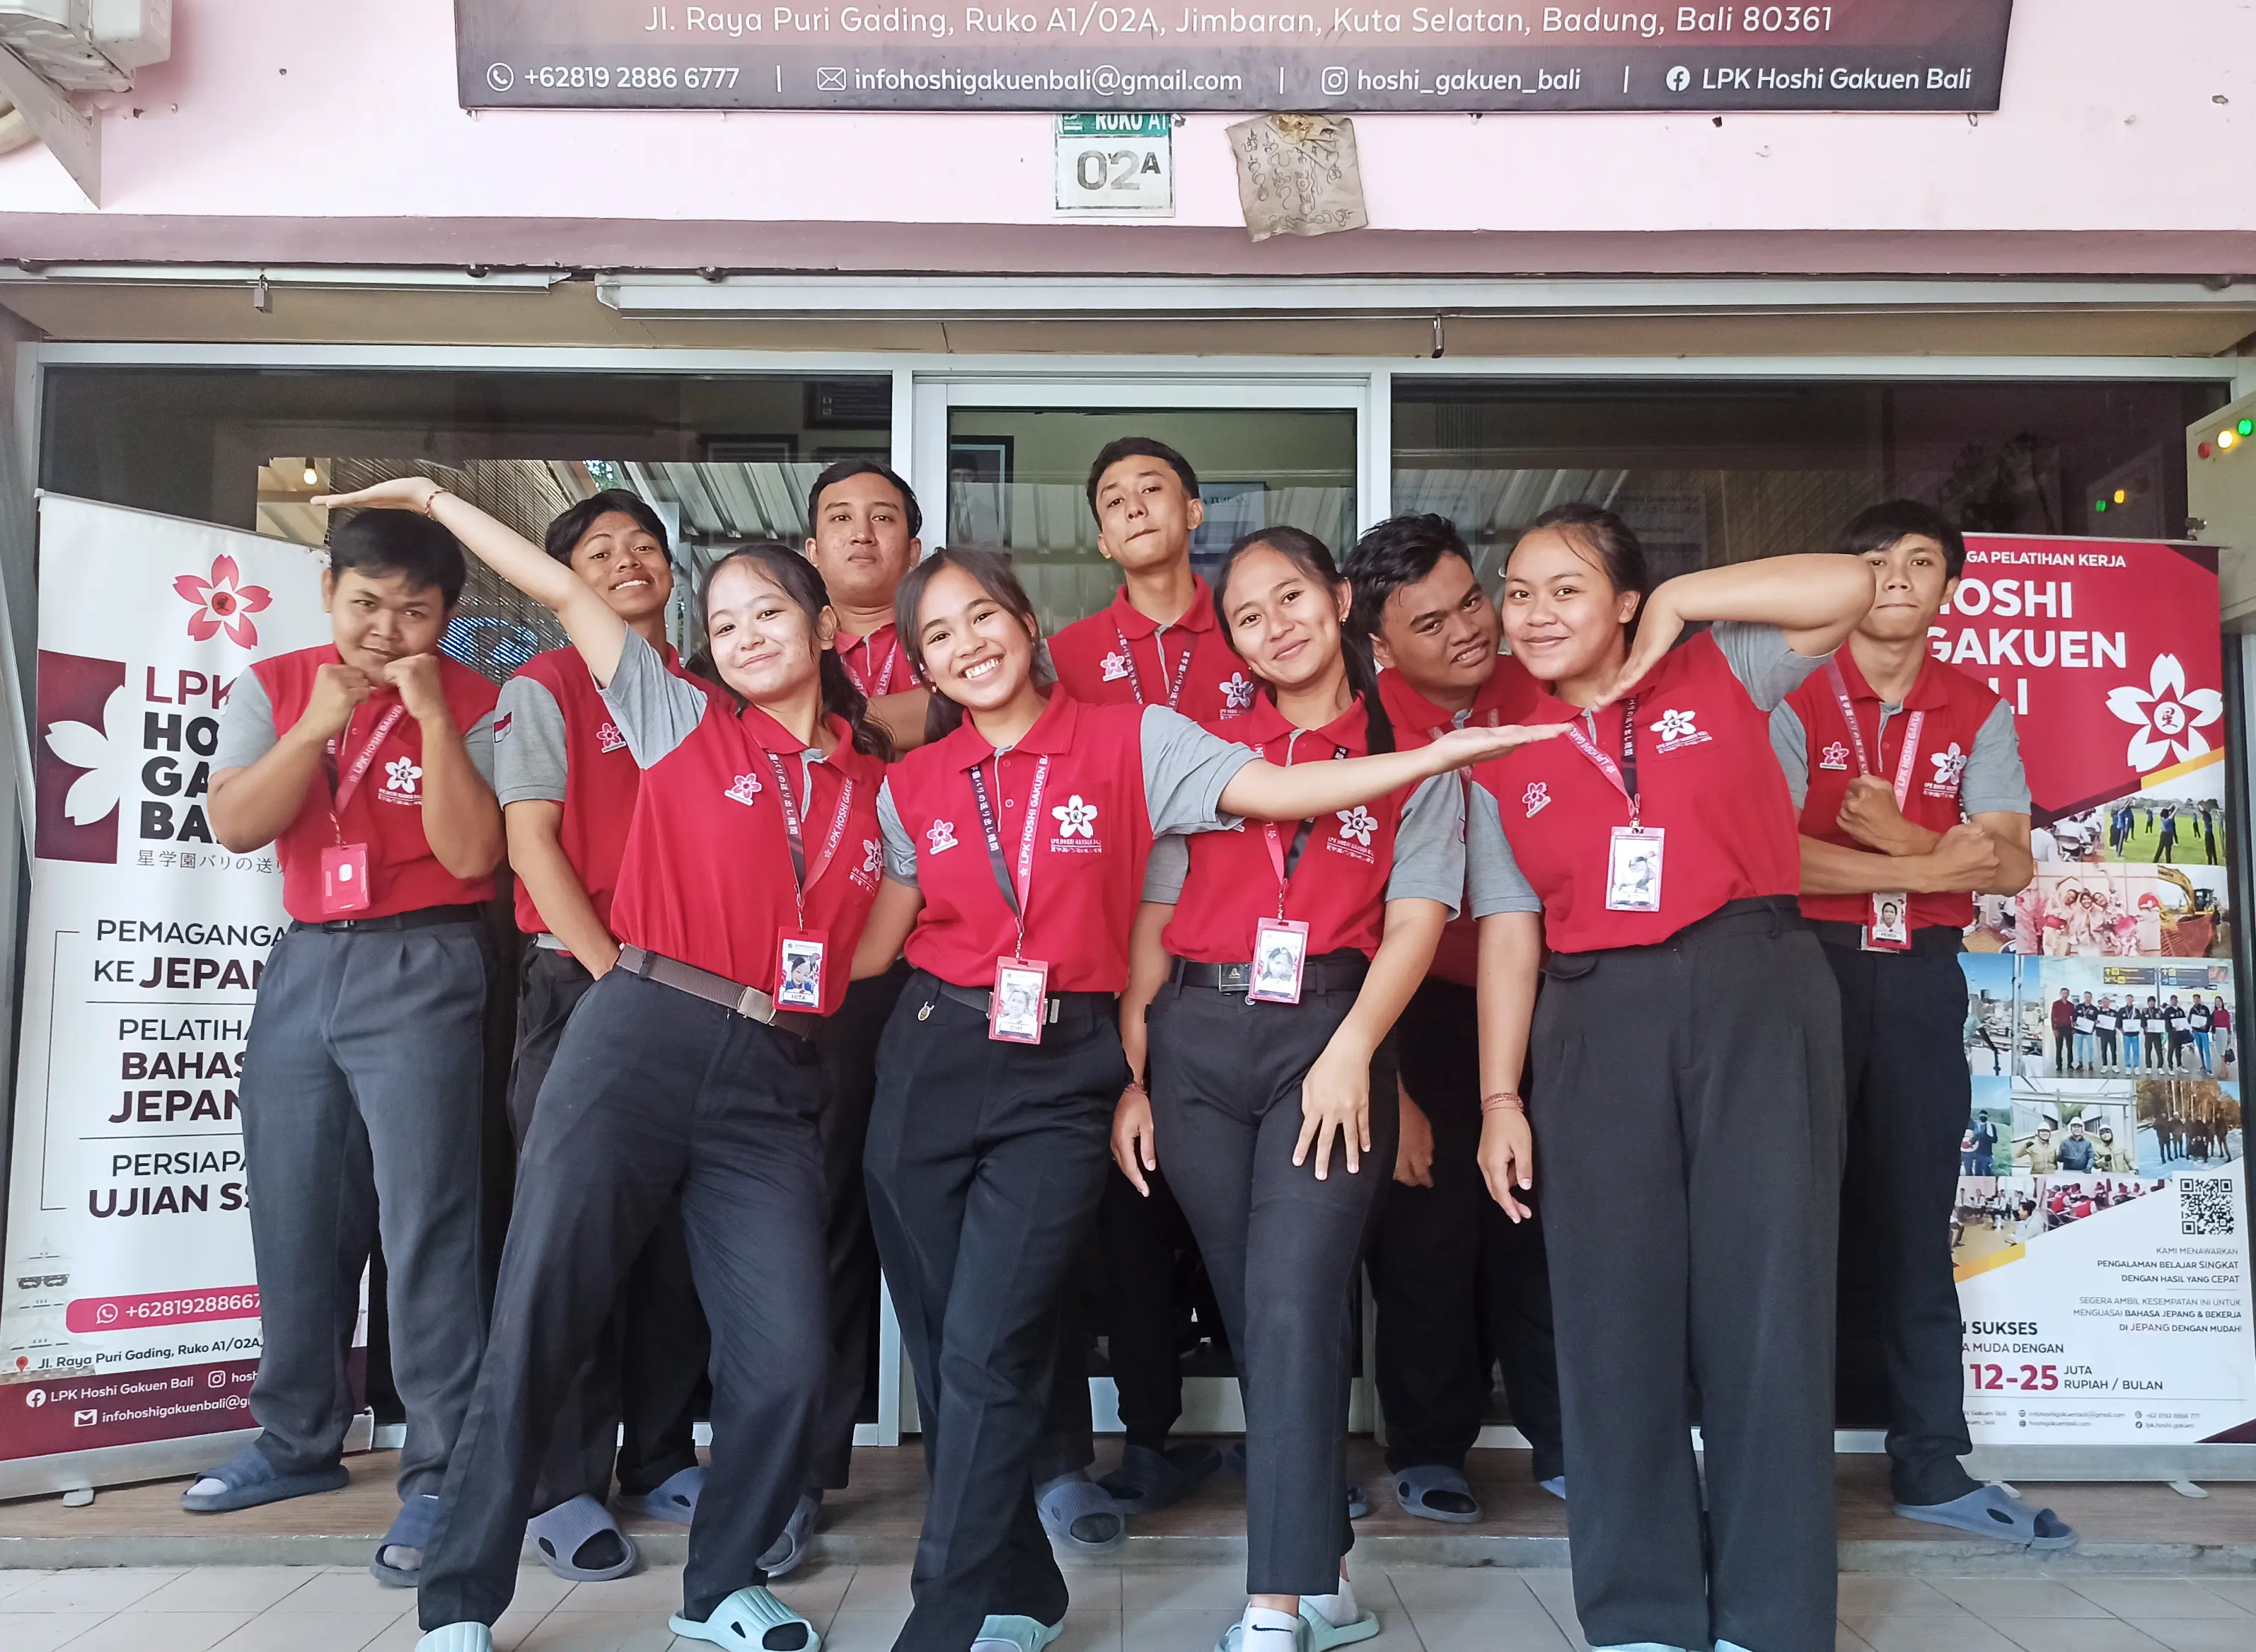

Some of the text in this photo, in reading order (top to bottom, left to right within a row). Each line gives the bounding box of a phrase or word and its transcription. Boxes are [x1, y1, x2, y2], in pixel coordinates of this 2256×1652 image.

[644, 1, 1832, 38] Jl. Raya Puri Gading, Ruko A1/02A, Jimbaran, Kuta Selatan, Badung, Bali 80361
[523, 67, 740, 88] +62819 2886 6777
[855, 64, 1242, 96] infohoshigakuenbali@gmail.com
[1358, 69, 1580, 95] hoshi_gakuen_bali
[1702, 68, 1972, 90] LPK Hoshi Gakuen Bali
[1965, 551, 2127, 567] GA PELATIHAN KERJA
[1939, 577, 2073, 618] OSHI
[1926, 626, 2127, 669] GAKUEN
[144, 711, 220, 757] HO
[141, 756, 210, 798] GA
[1030, 767, 1046, 807] GAKUEN
[140, 800, 221, 845] BA
[835, 802, 848, 830] HOSHI
[1023, 808, 1037, 842] HOSHI
[830, 829, 842, 849] LPK
[1019, 844, 1031, 865] LPK
[95, 961, 134, 983] KE
[119, 1019, 249, 1041] PELATIH
[88, 1182, 250, 1218] UJIAN S
[2097, 1260, 2157, 1269] PENGALAMAN
[2199, 1261, 2238, 1270] SINGKAT
[2121, 1274, 2158, 1283] DENGAN
[2160, 1275, 2185, 1283] HASIL
[2211, 1276, 2240, 1284] CEPAT
[2079, 1297, 2112, 1305] SEGERA
[2141, 1298, 2198, 1306] KESEMPATAN
[2161, 1310, 2195, 1319] JEPANG
[1972, 1322, 2038, 1336] SUKSES
[2130, 1323, 2170, 1332] JEPANG
[38, 1358, 53, 1370] Jl.
[57, 1353, 92, 1369] Raya
[96, 1349, 122, 1364] Puri
[125, 1346, 175, 1361] Gading,
[178, 1342, 209, 1355] Ruko
[1972, 1343, 2010, 1353] MUDA
[2013, 1344, 2064, 1353] DENGAN
[1969, 1363, 2059, 1391] 12-25
[2064, 1365, 2093, 1375] JUTA
[50, 1376, 194, 1403] LPK Hoshi Gakuen Bali
[2064, 1380, 2108, 1390] RUPIAH
[2122, 1380, 2163, 1390] BULAN
